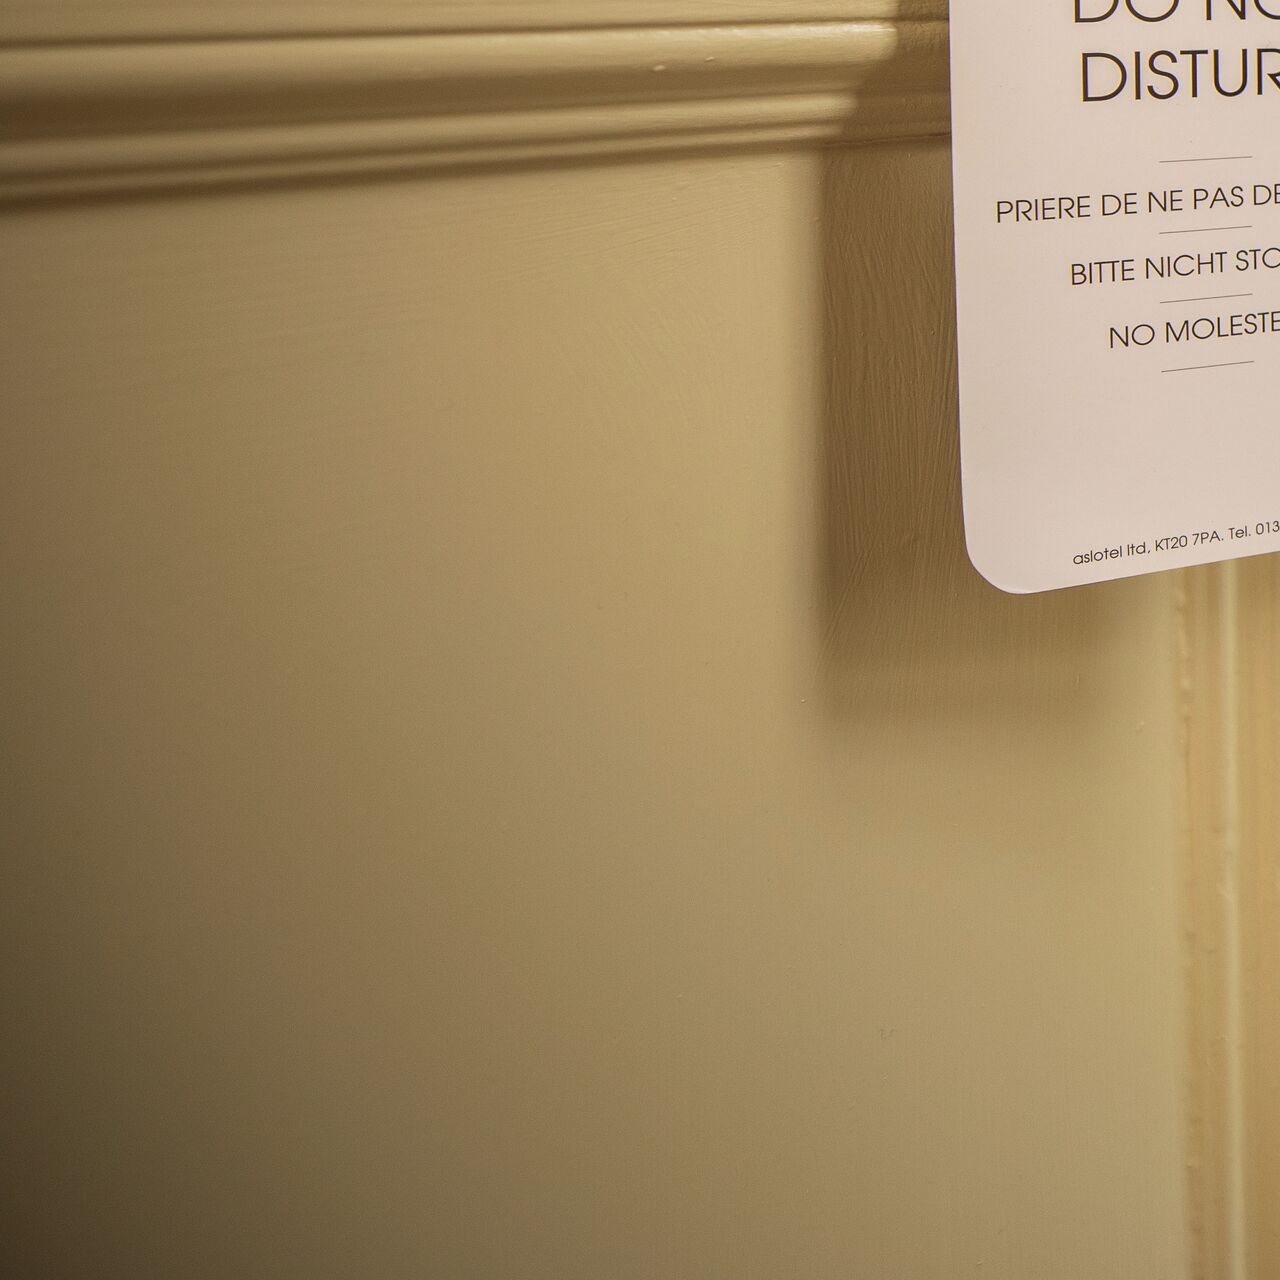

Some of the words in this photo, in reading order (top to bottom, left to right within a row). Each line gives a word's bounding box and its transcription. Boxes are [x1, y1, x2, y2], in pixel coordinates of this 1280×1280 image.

[996, 195, 1092, 224] PRIERE
[1101, 193, 1138, 217] DE
[1147, 189, 1184, 214] NE
[1193, 185, 1245, 211] PAS
[1070, 259, 1136, 286] BITTE
[1145, 250, 1228, 280] NICHT
[1109, 324, 1156, 350] NO
[1072, 545, 1123, 565] aslotel
[1154, 535, 1188, 552] KT20
[1192, 531, 1224, 546] 7PA.
[1228, 525, 1252, 540] Tel.
